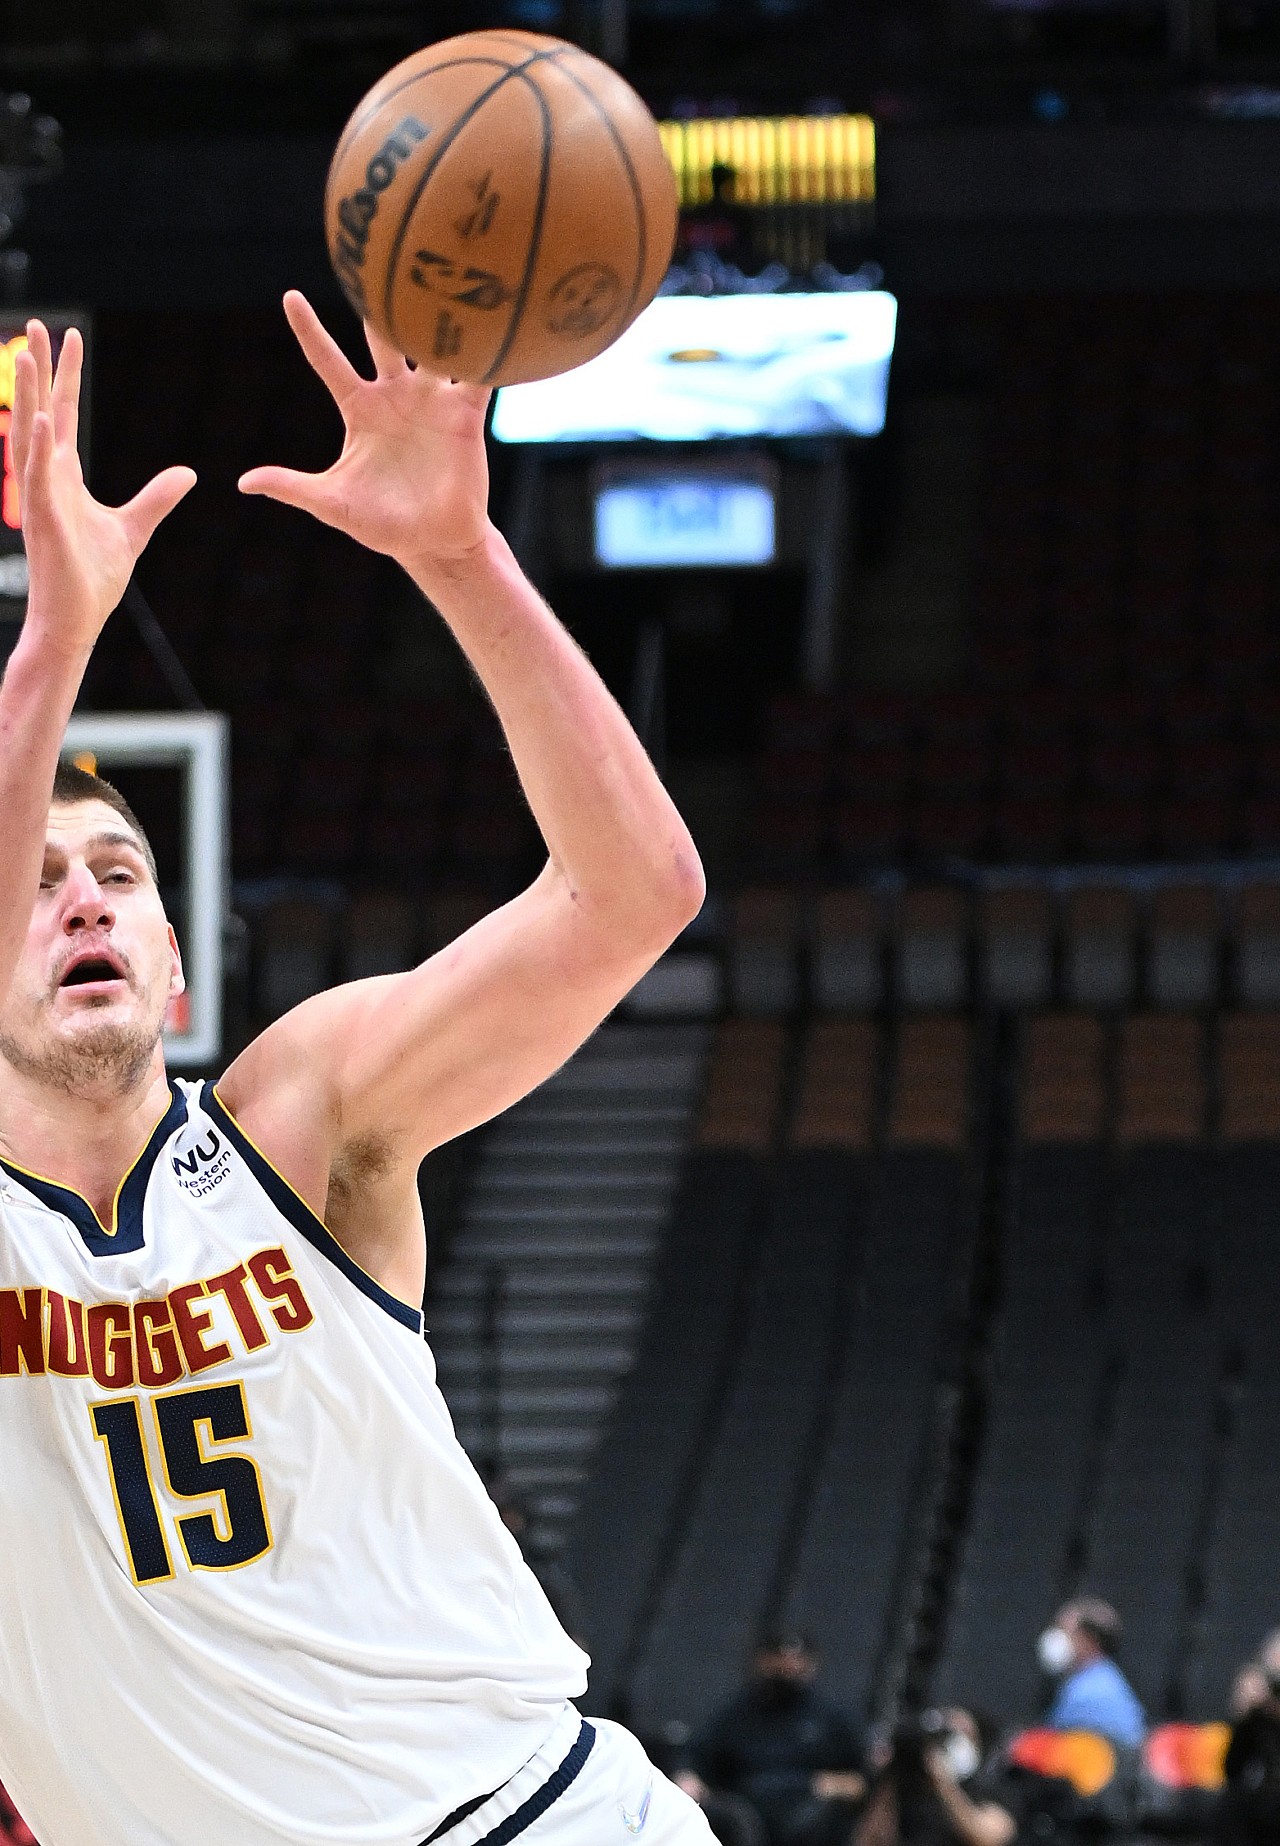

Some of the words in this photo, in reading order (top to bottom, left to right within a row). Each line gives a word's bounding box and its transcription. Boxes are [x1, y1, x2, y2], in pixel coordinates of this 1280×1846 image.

[172, 1128, 220, 1177] WU
[178, 1150, 231, 1189] Western
[189, 1167, 231, 1198] Union
[87, 1378, 275, 1587] 15
